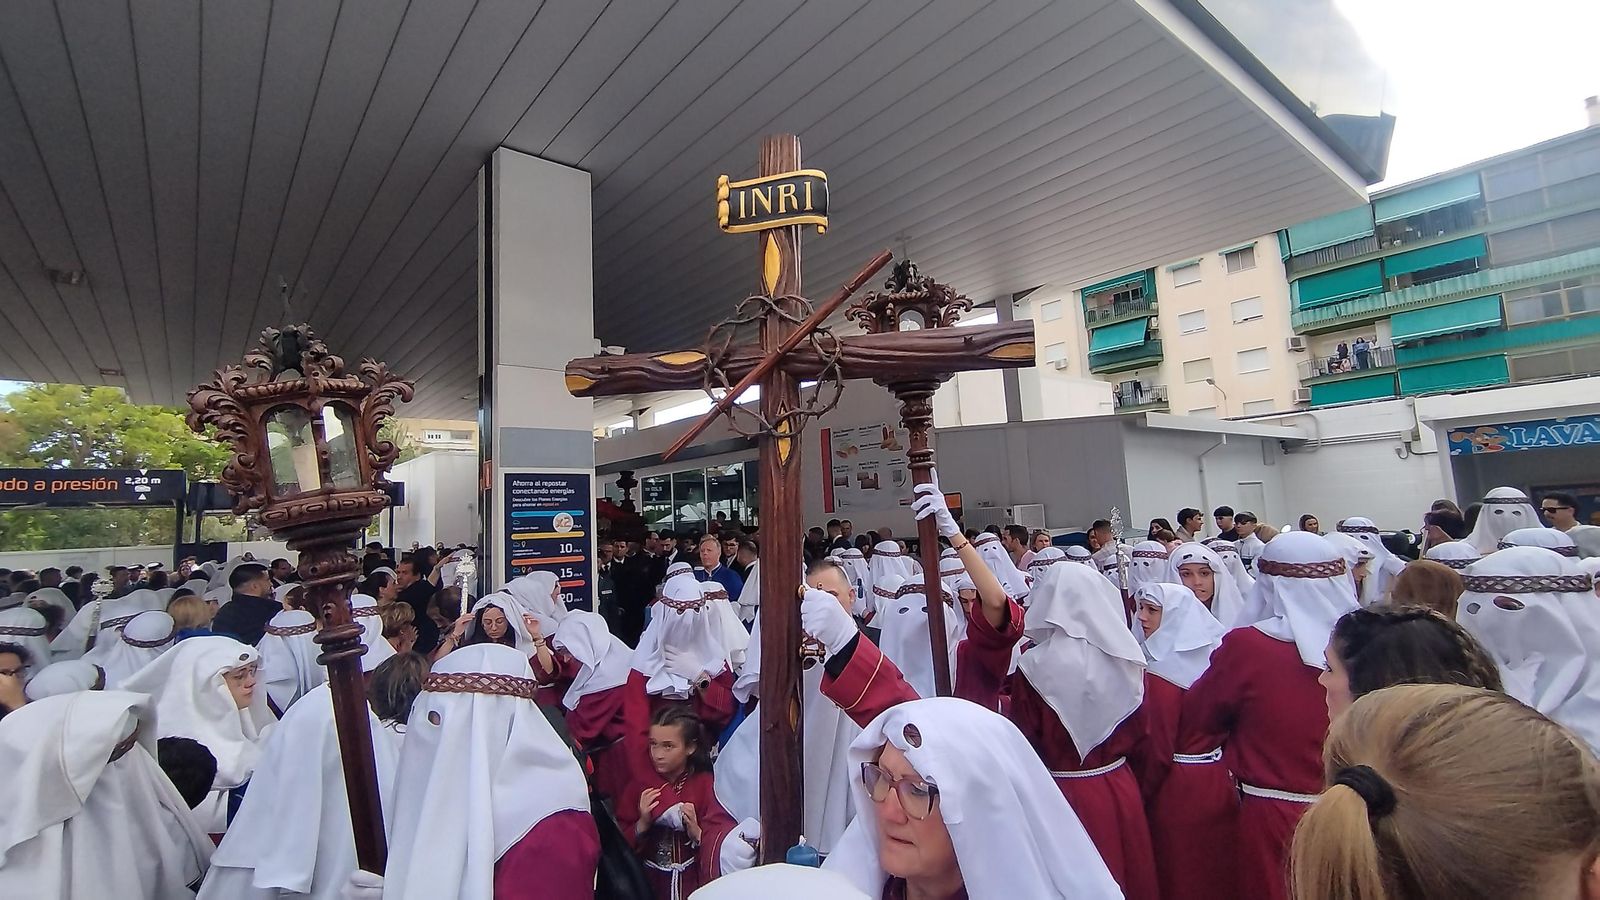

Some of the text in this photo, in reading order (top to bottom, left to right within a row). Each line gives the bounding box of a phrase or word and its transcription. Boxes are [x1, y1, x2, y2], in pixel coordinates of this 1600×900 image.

[738, 181, 814, 219] INRI
[0, 477, 119, 494] do a presión
[124, 477, 161, 485] 2,20 m
[542, 480, 567, 488] repostar
[559, 543, 573, 554] 10
[560, 568, 573, 578] 15
